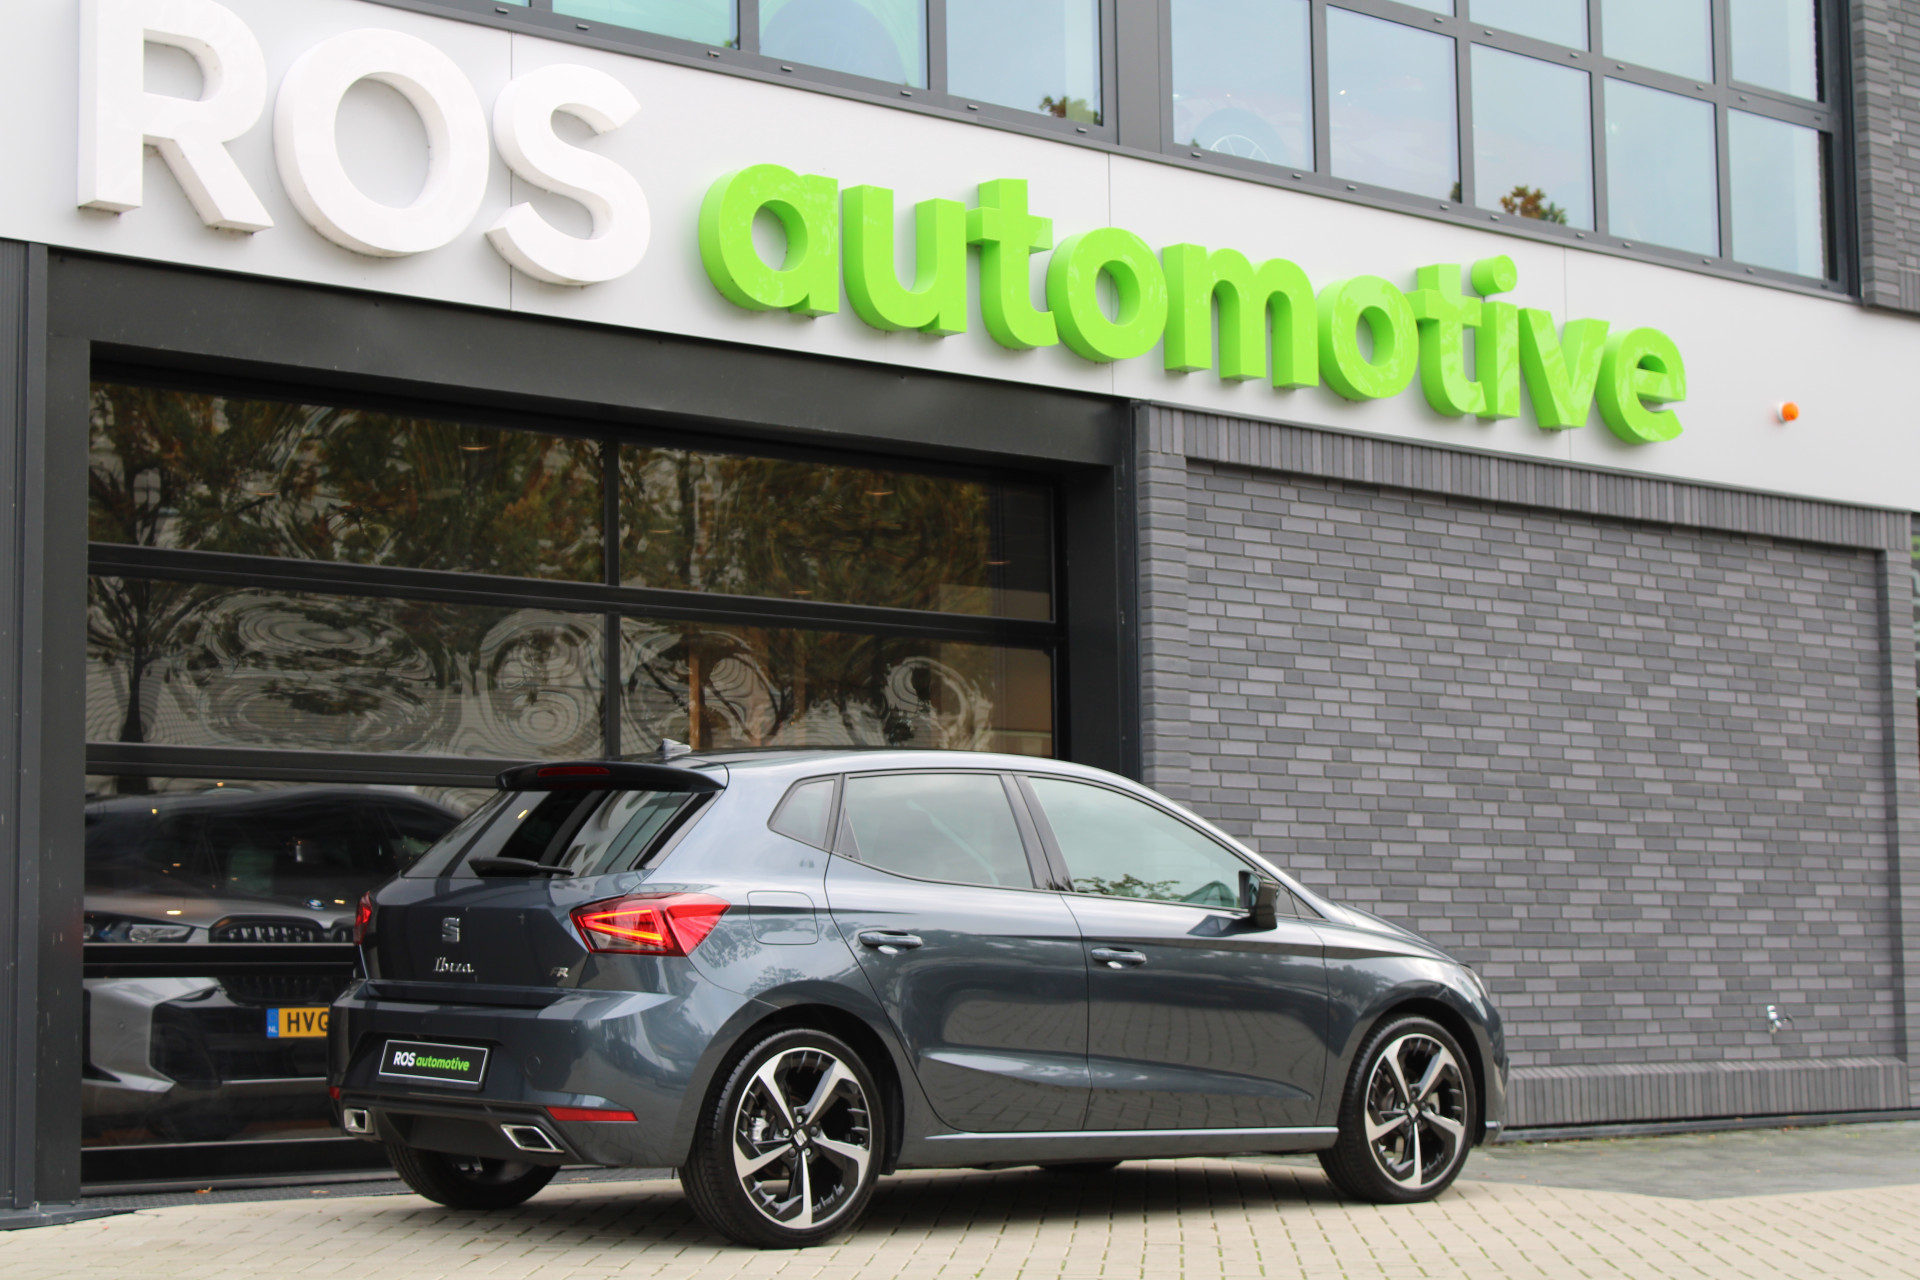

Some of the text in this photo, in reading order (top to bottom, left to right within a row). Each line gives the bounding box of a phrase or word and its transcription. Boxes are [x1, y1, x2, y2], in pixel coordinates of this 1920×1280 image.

[77, 0, 1688, 444] ROS automotive
[268, 1025, 278, 1033] NL
[393, 1051, 470, 1071] ROS automotive
